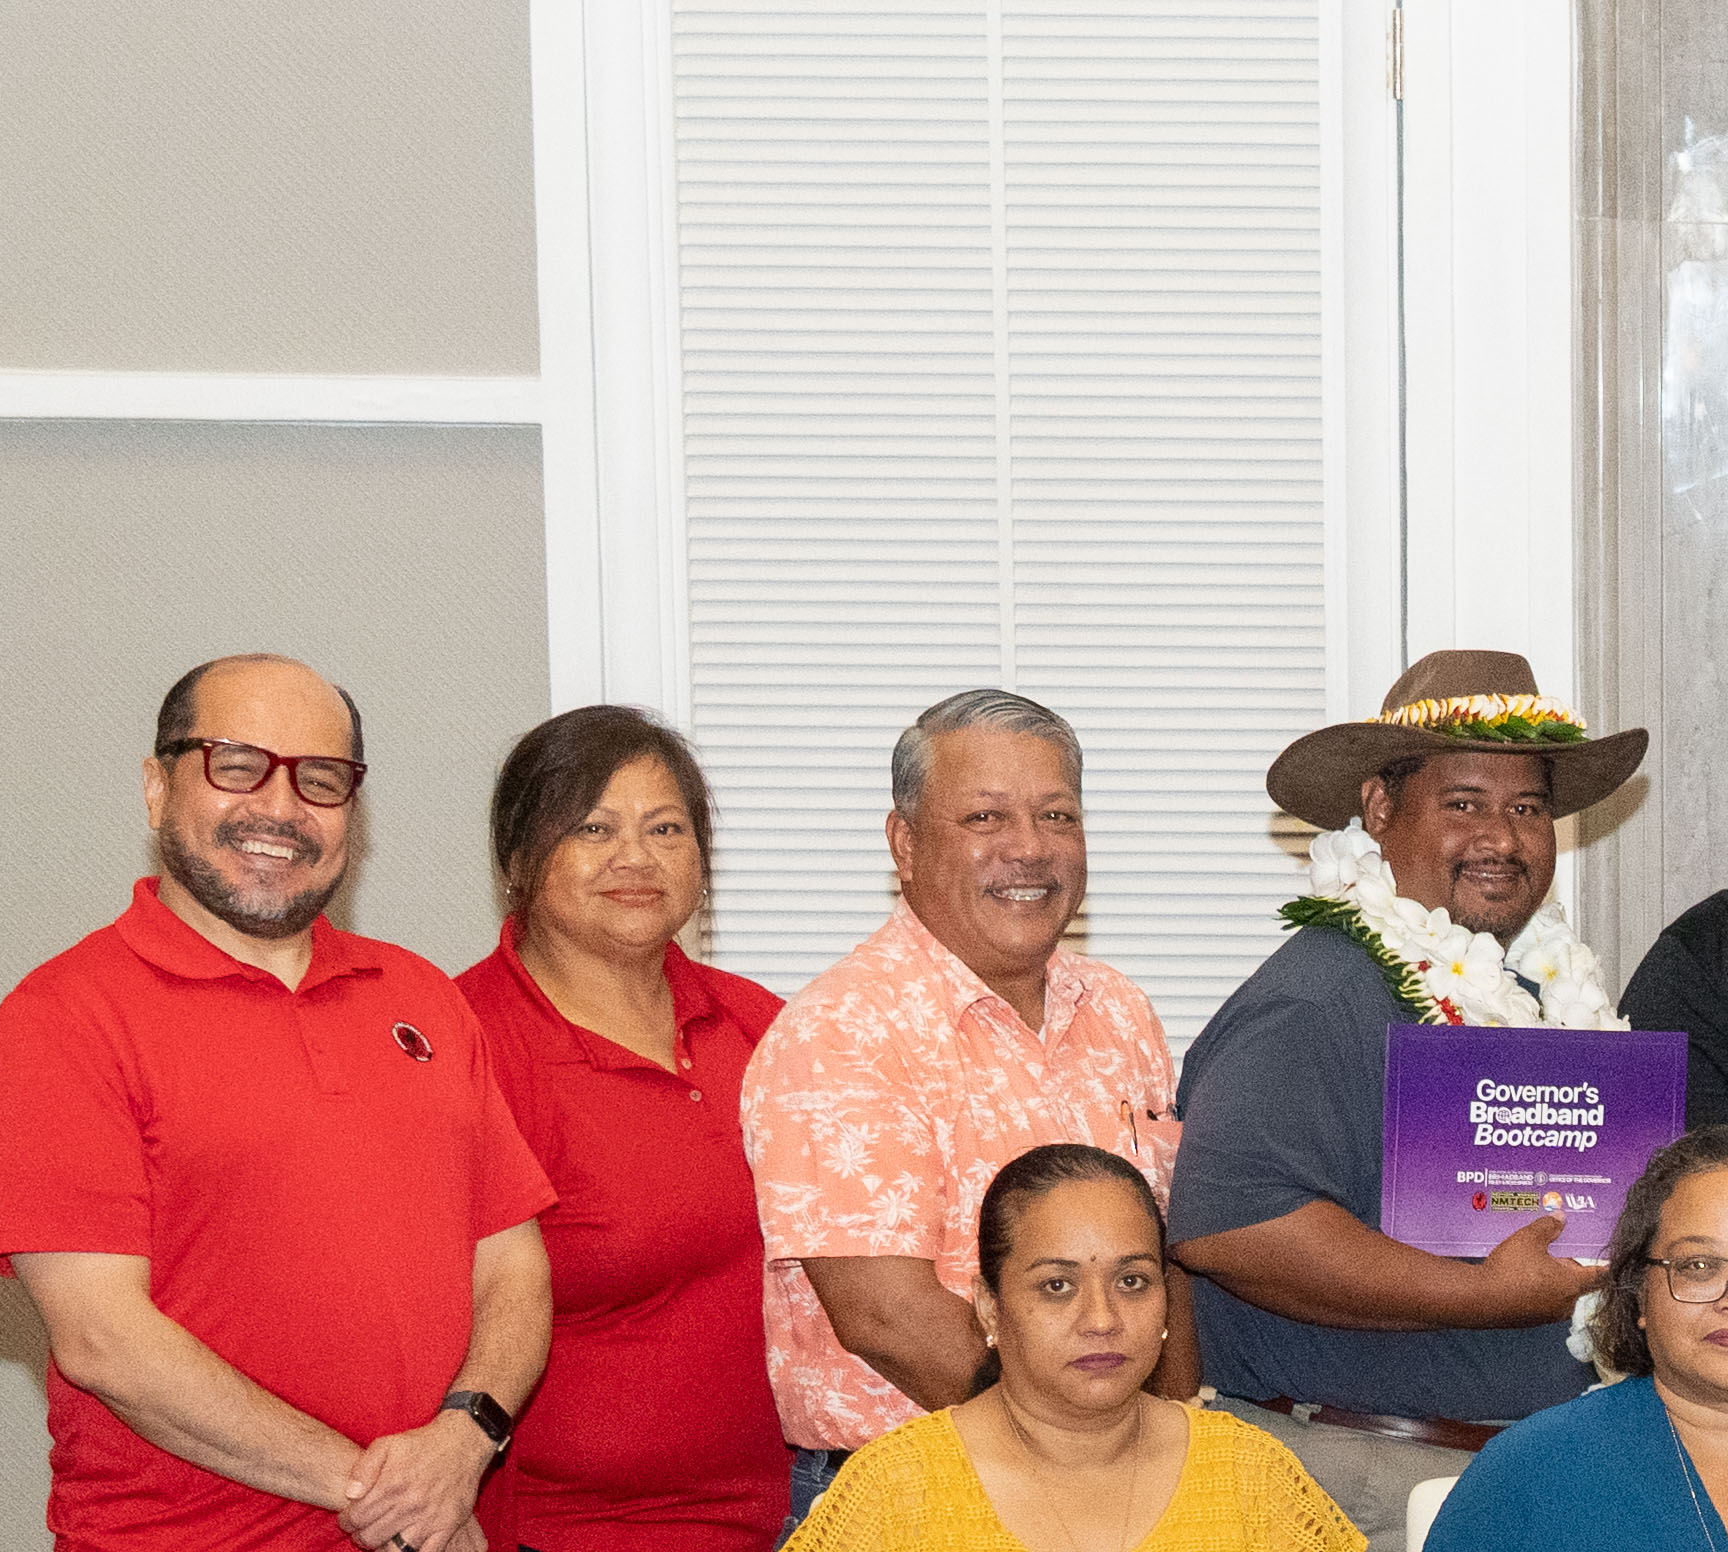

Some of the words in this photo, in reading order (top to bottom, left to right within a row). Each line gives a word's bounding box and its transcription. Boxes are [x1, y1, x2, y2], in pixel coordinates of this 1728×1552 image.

[1476, 1079, 1599, 1104] Governor's
[1474, 1124, 1597, 1152] Bootcamp
[1457, 1171, 1484, 1183] BPD
